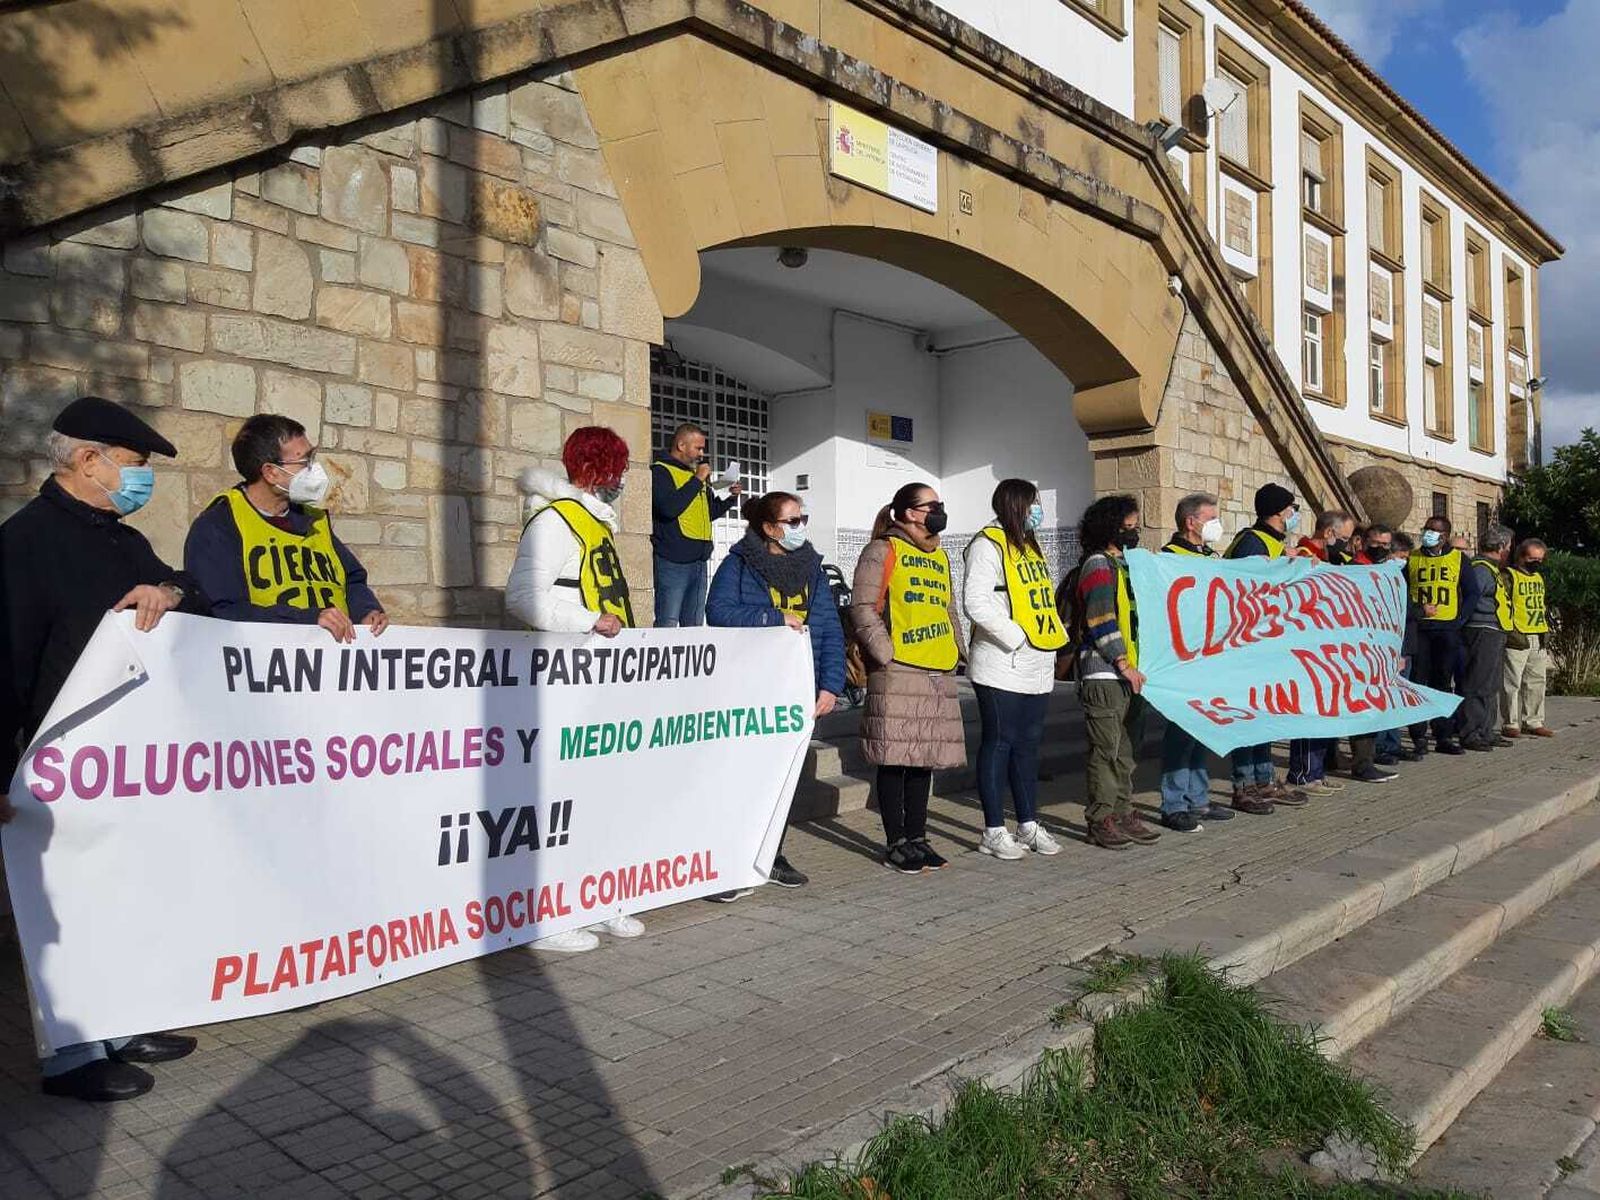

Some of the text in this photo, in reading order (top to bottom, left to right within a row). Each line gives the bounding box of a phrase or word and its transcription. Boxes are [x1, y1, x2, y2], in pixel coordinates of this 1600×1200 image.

[1418, 564, 1449, 581] CIE
[1418, 586, 1449, 606] NO
[1036, 614, 1056, 634] YA
[1527, 610, 1544, 626] YA
[223, 644, 716, 692] PLAN INTEGRAL PARTICIPATIVO
[31, 704, 806, 804] SOLUCIONES SOCIALES Y MEDIO AMBIENTALES
[211, 849, 719, 1001] PLATAFORMA SOCIAL COMARCAL
